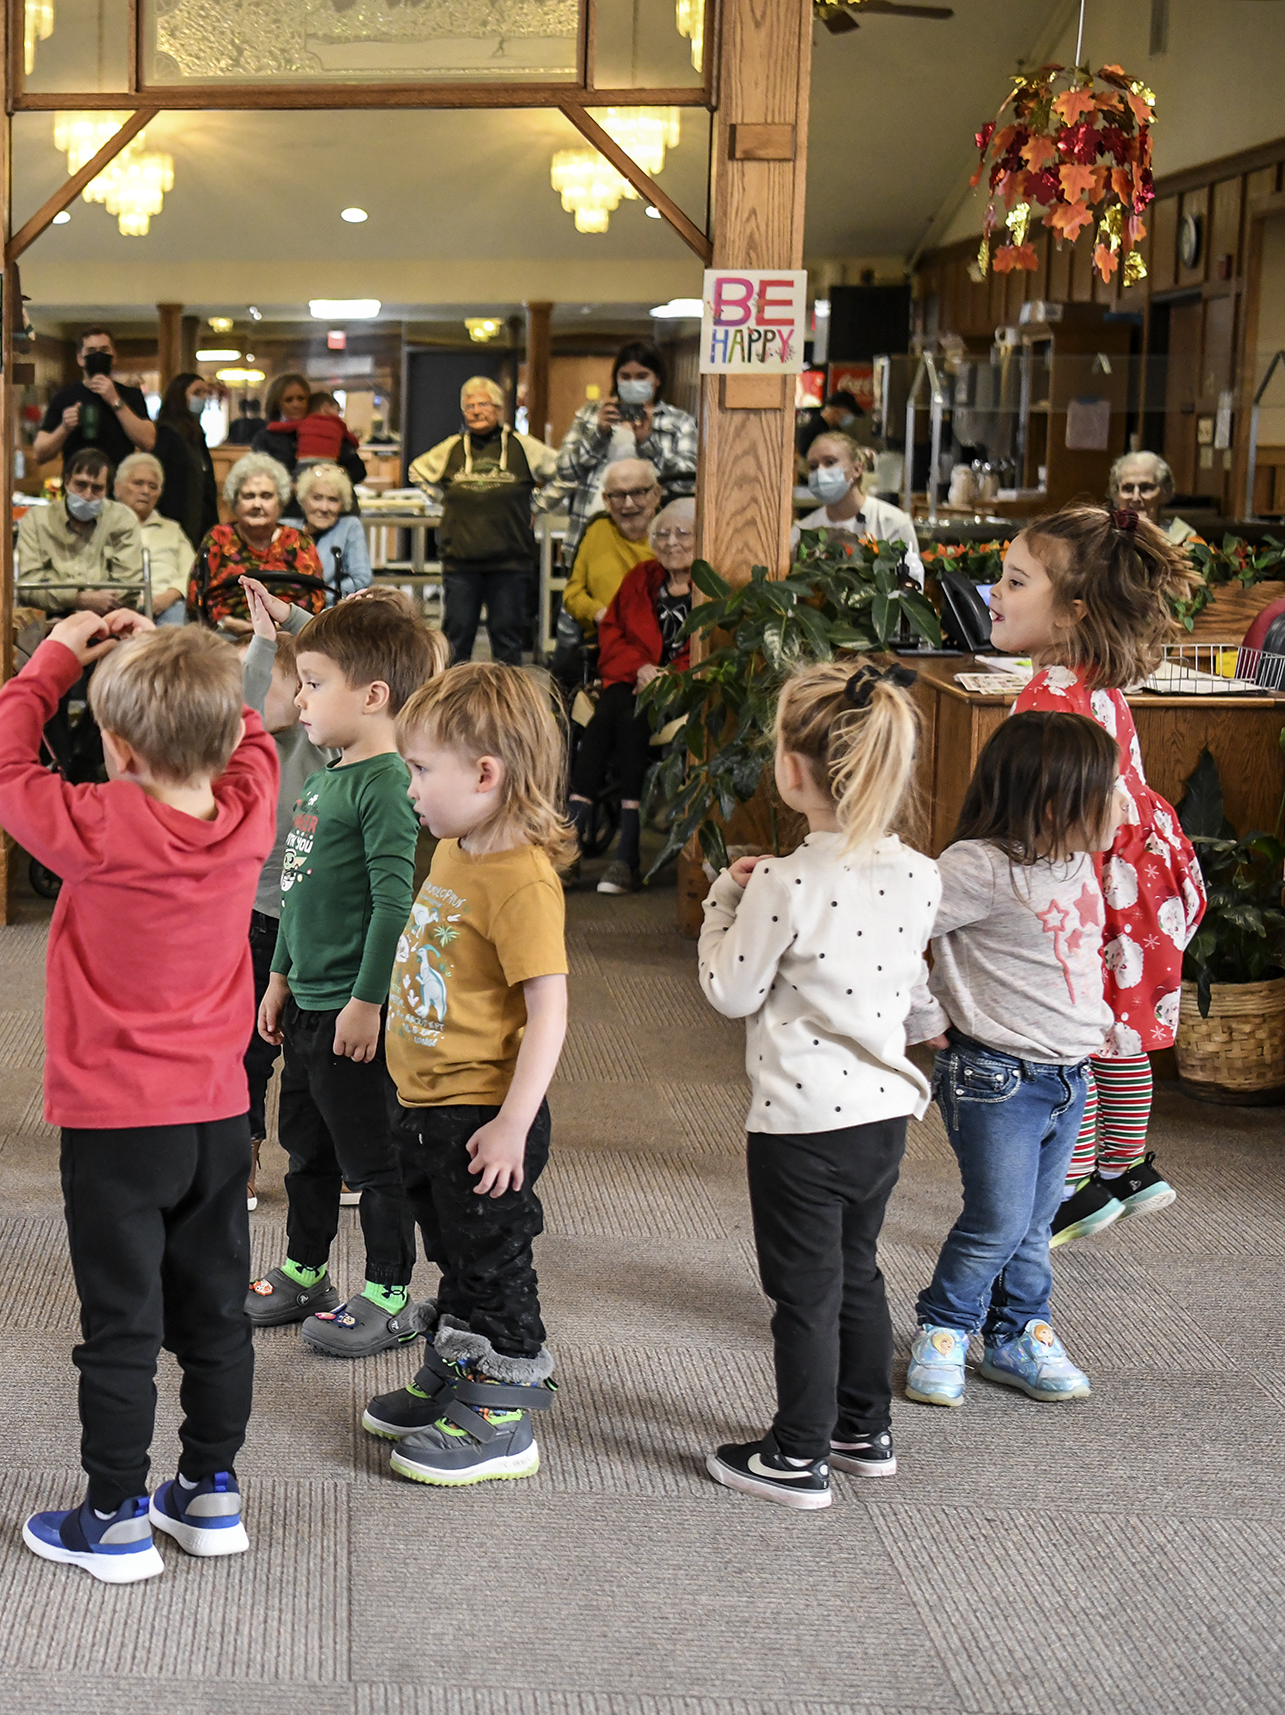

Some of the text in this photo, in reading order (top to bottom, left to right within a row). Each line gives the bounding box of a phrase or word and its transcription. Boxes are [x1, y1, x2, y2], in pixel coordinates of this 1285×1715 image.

[713, 277, 795, 326] BE
[710, 328, 795, 364] HAPPY
[296, 838, 313, 853] YOU
